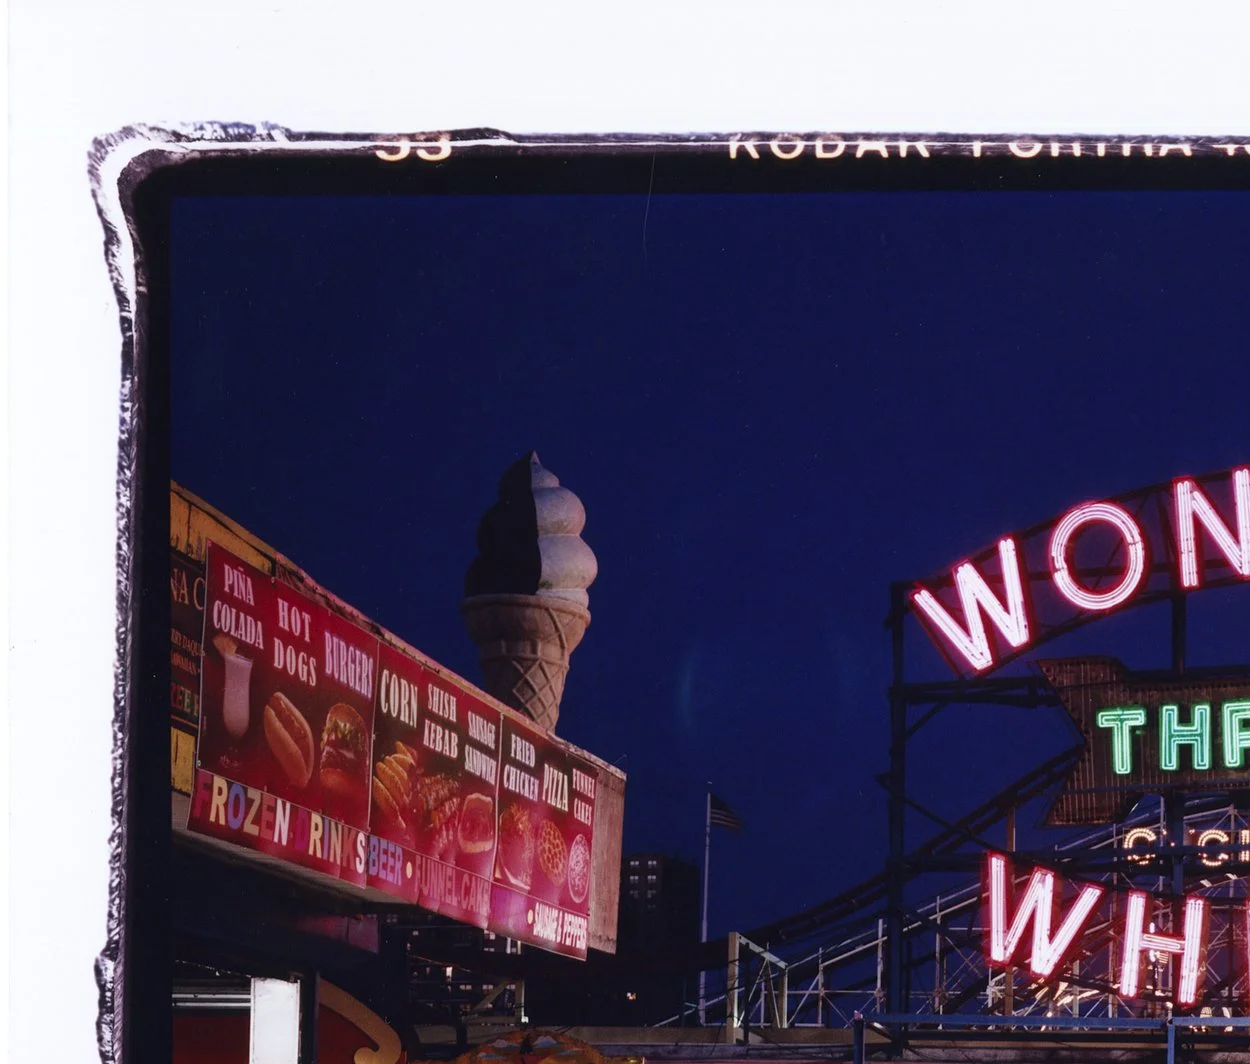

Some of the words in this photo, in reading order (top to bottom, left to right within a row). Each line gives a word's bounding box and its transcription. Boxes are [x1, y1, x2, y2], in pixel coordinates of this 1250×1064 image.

[224, 563, 255, 606] PIÑA
[213, 600, 264, 649] COLADA
[277, 598, 311, 642] HOT
[273, 637, 317, 686] DOGS
[324, 631, 373, 699] BURGERS
[380, 669, 418, 728] CORN
[427, 684, 457, 722] SHISH
[423, 719, 458, 759] KEBAB
[468, 711, 495, 749] SAUSAGE
[511, 734, 536, 768] FRIED
[465, 744, 497, 785] SANDWICH
[503, 764, 539, 800] CHICKEN
[573, 768, 595, 799] FUNNEL
[542, 763, 568, 812] PIZZA
[194, 772, 290, 846] FROZEN
[295, 808, 365, 874] DRINKS
[574, 798, 592, 826] CAKES
[369, 834, 402, 886] BEER
[415, 855, 457, 907] FUNNEL
